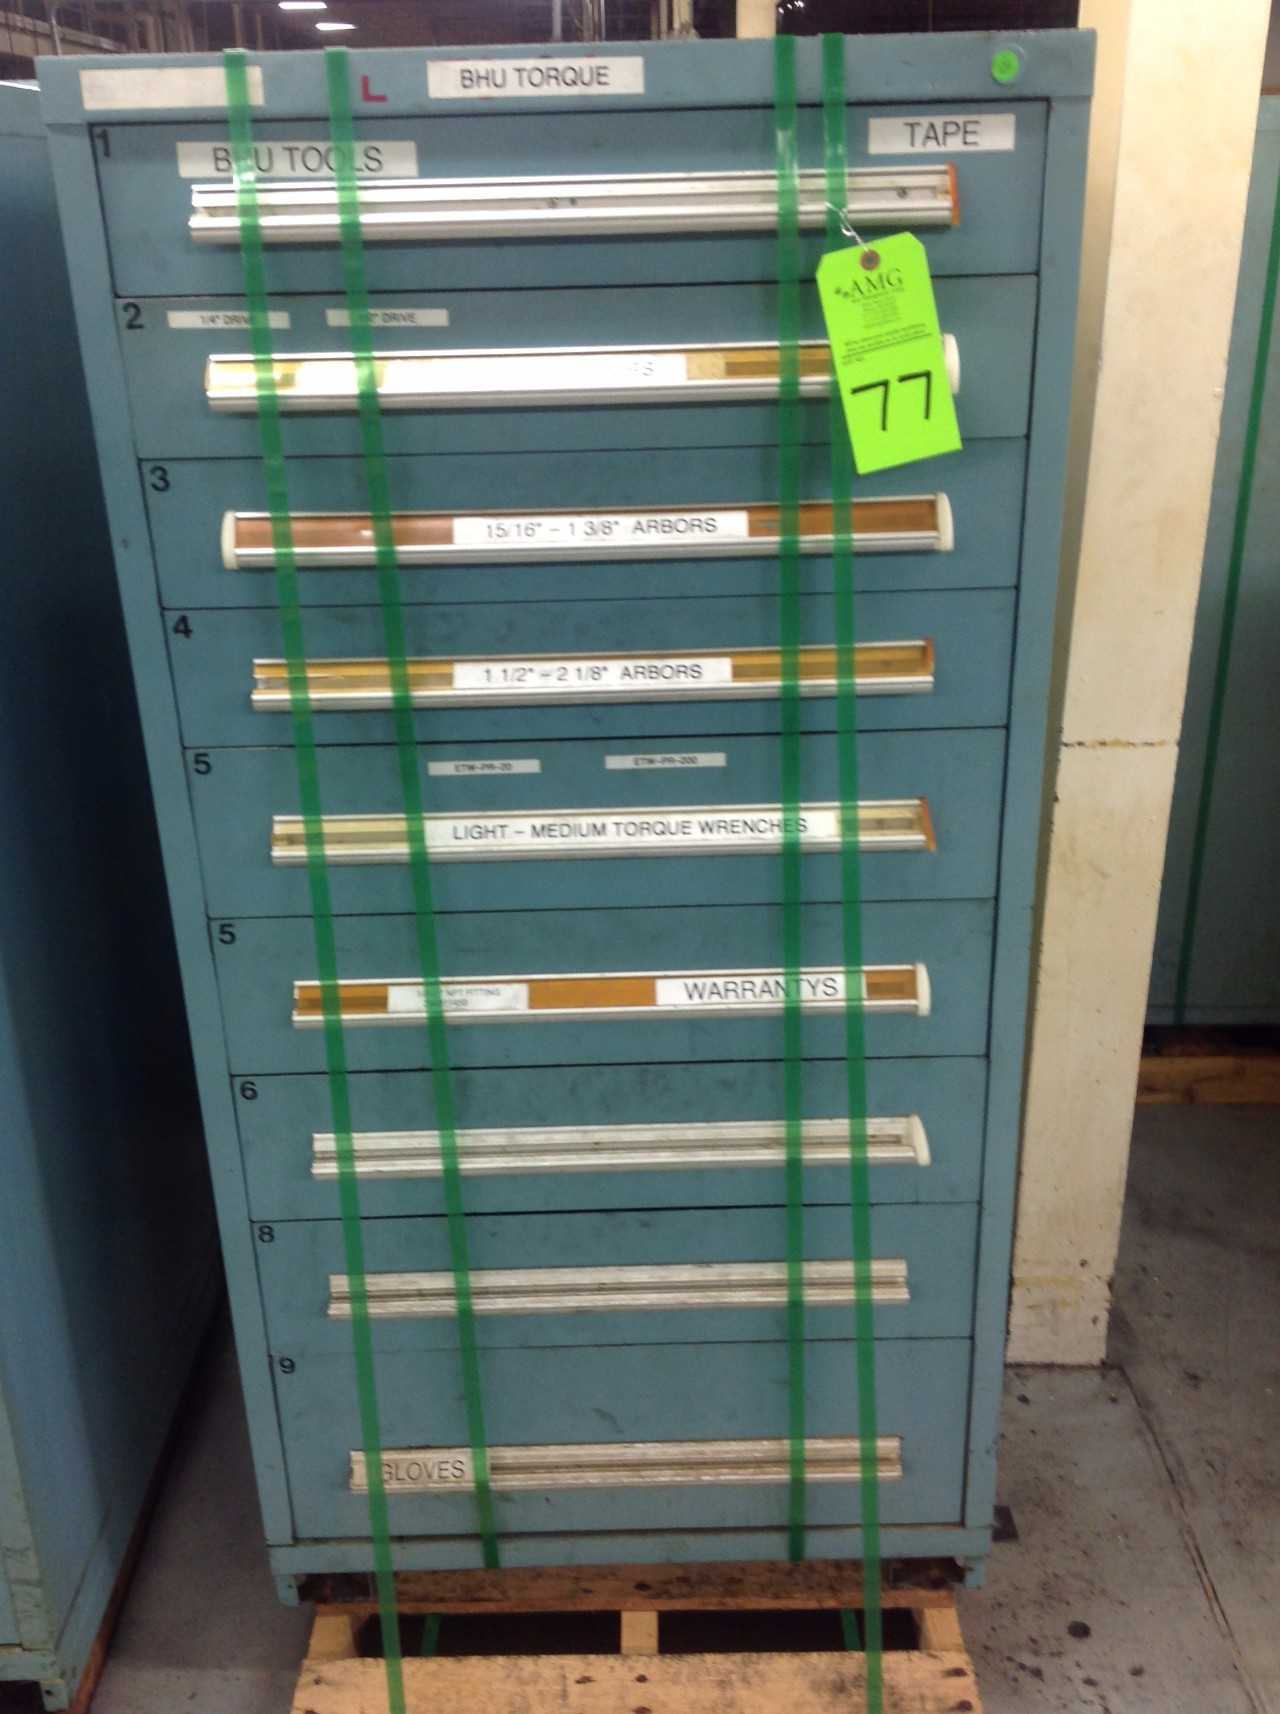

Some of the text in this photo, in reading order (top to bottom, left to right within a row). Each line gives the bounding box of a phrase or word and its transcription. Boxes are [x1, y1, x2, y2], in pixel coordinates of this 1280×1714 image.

[360, 75, 388, 102] L
[459, 64, 611, 89] BHU TORQUE
[95, 128, 111, 158] 1
[903, 119, 980, 148] TAPE
[213, 146, 274, 173] BU
[849, 267, 904, 298] AMG
[122, 302, 145, 330] 2
[850, 370, 932, 432] 77
[149, 465, 171, 492] 3
[486, 522, 543, 539] 15/16"
[568, 521, 577, 537] 1
[584, 519, 620, 536] 3/8"
[632, 517, 719, 535] ARBORS
[173, 614, 192, 638] 4
[484, 668, 493, 683] 1
[501, 667, 534, 683] 1/2"
[556, 666, 569, 682] 2
[576, 665, 608, 681] 1/8"
[619, 664, 704, 681] ARBORS
[193, 752, 212, 775] 5
[452, 824, 508, 841] LIGHT
[530, 820, 608, 838] MEDIUM
[613, 819, 693, 837] TORQUE
[698, 817, 809, 835] WRENCHES
[218, 923, 237, 945] 5
[684, 977, 839, 1001] WARRANTYS
[239, 1080, 258, 1101] 6
[257, 1224, 275, 1243] 8
[278, 1357, 296, 1374] 9
[379, 1459, 465, 1482] GLOVES
